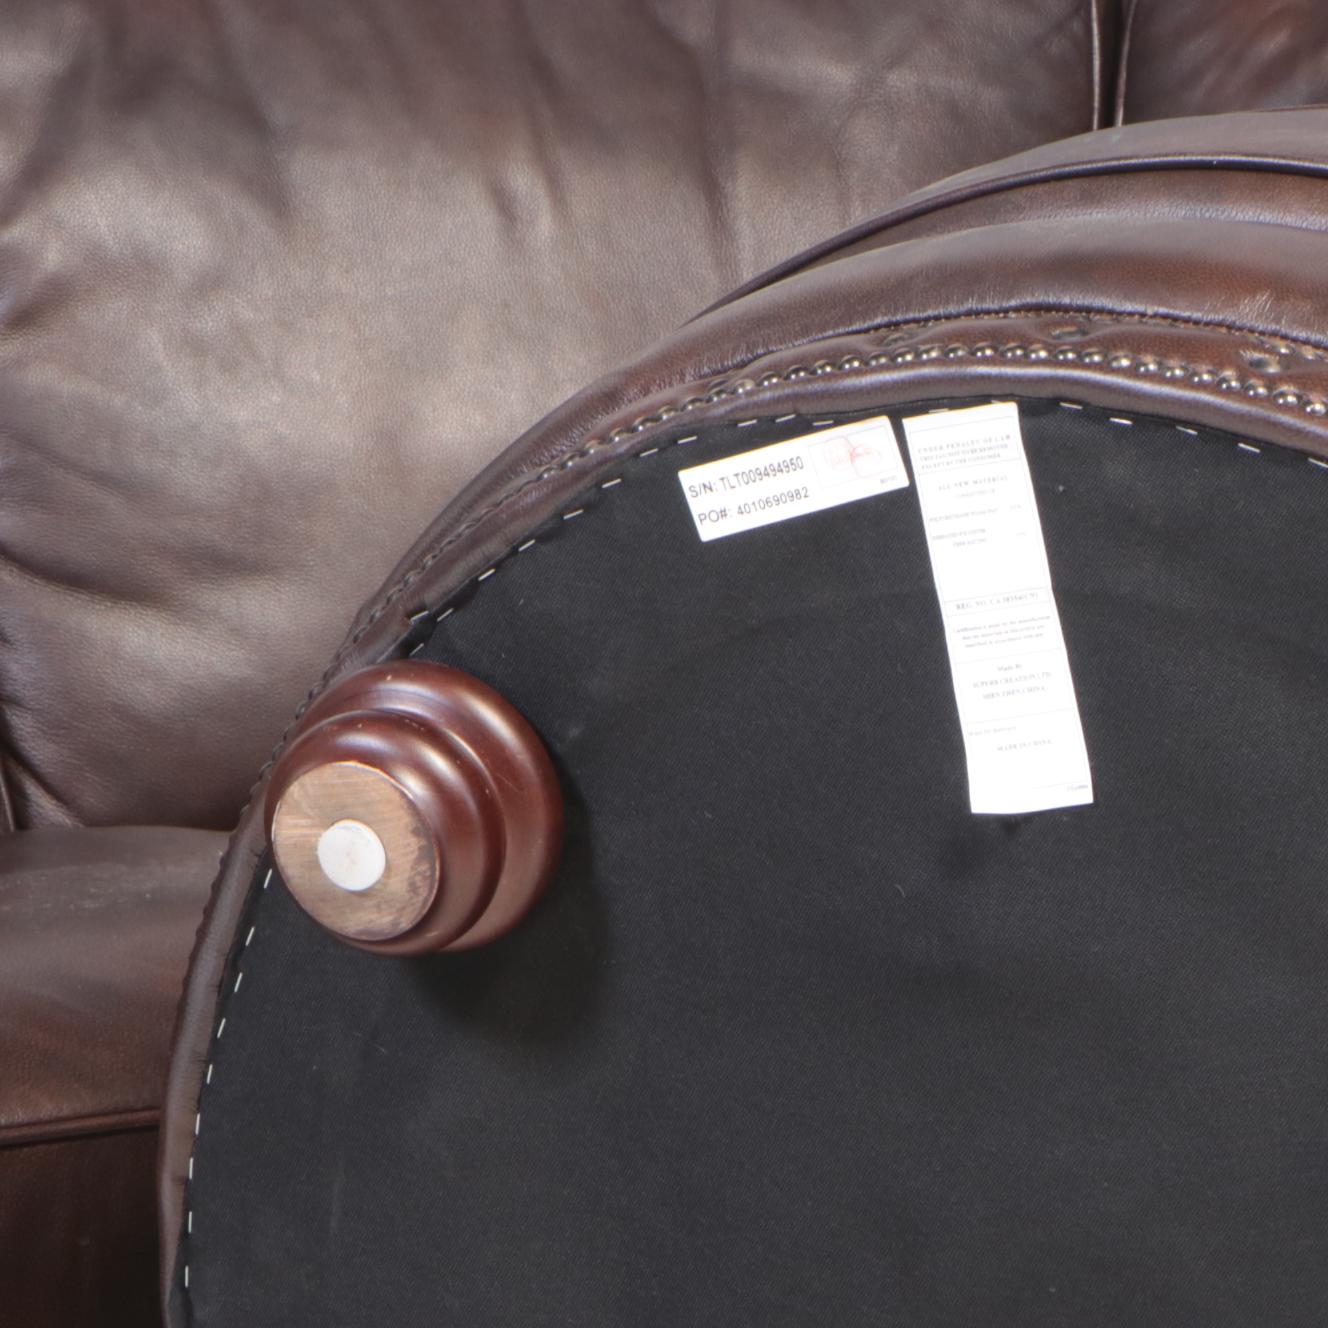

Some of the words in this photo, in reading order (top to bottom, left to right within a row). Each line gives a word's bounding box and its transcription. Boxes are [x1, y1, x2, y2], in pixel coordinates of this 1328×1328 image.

[688, 481, 719, 498] S/N:
[719, 456, 804, 492] TLT009494950
[698, 507, 733, 526] PO#:
[737, 486, 809, 516] 4010690982
